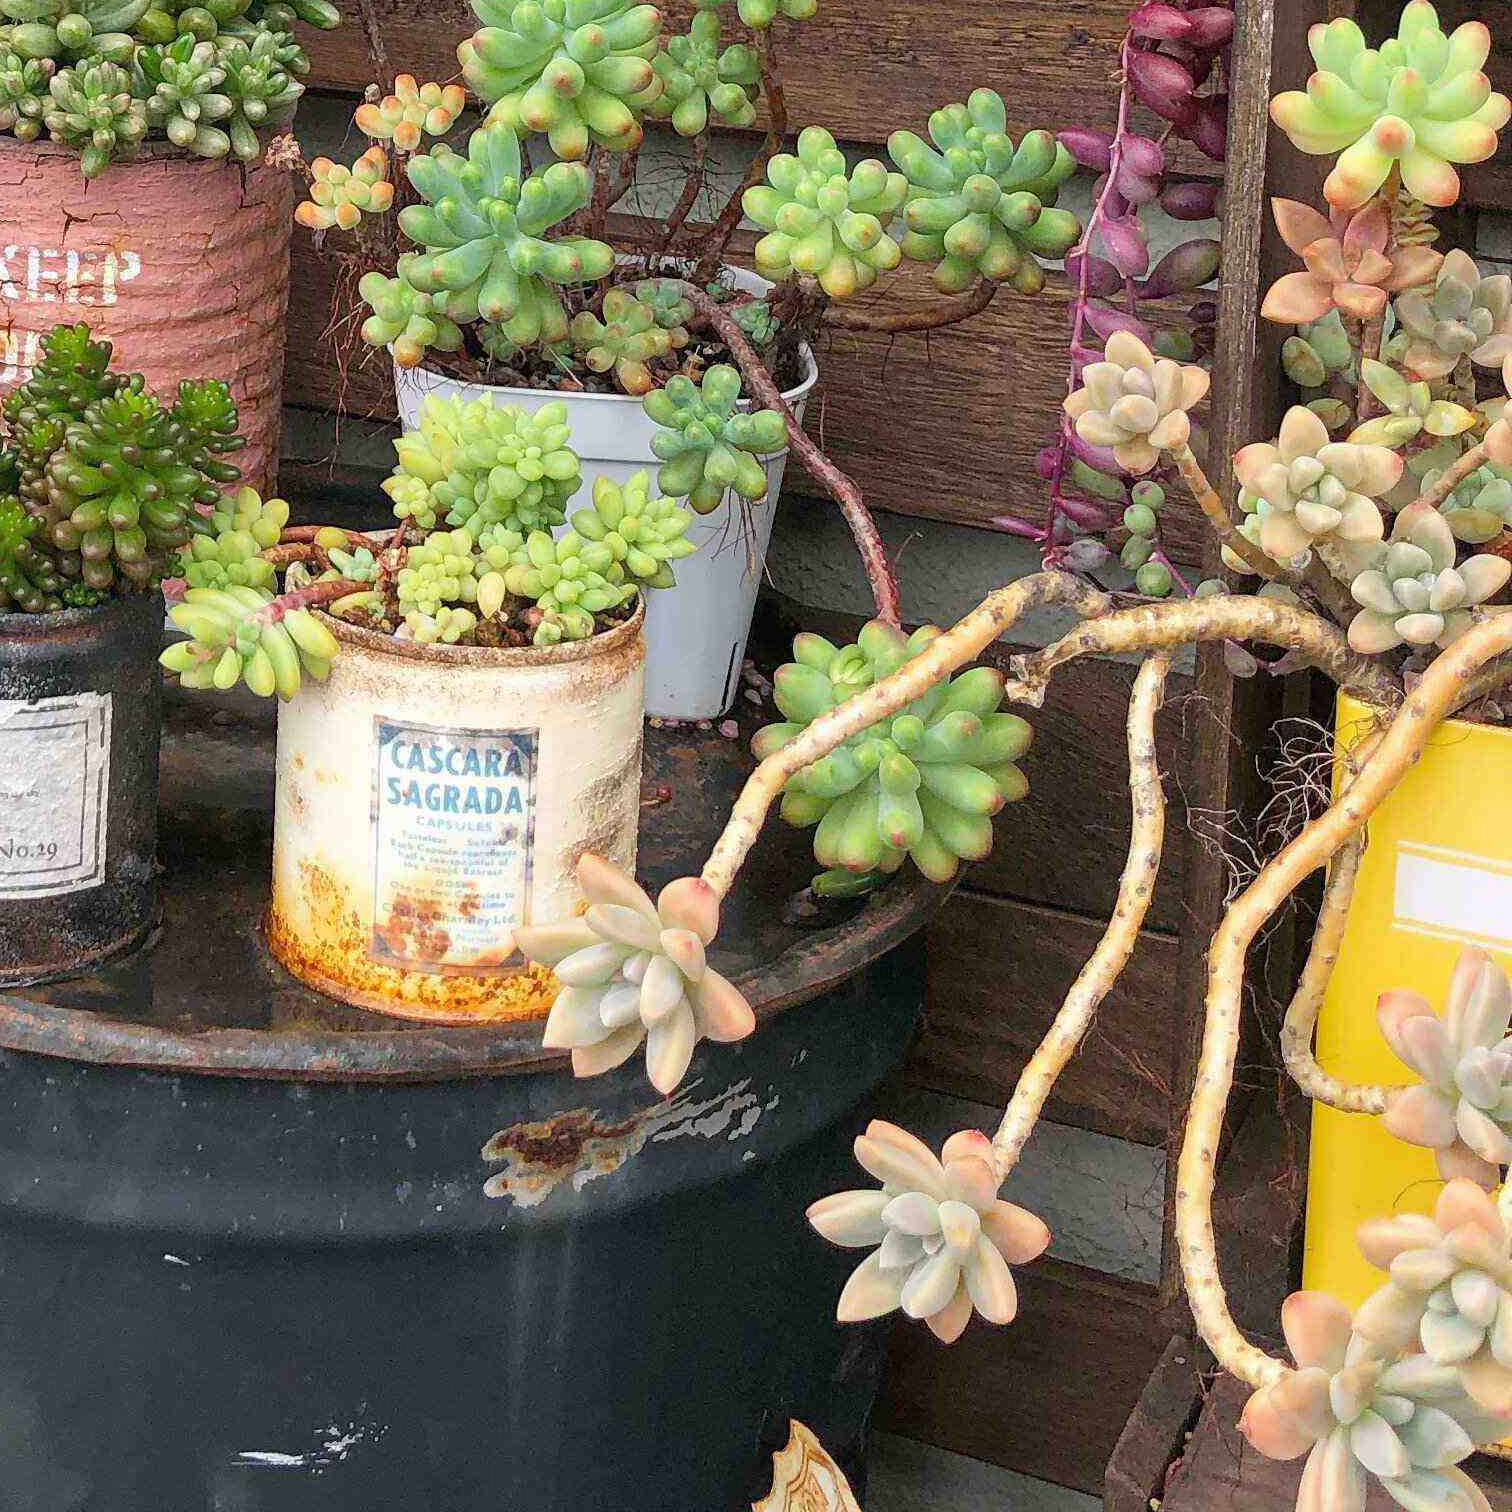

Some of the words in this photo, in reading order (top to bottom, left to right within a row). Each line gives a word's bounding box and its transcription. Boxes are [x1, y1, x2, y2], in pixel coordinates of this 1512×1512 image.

[390, 739, 524, 778] CASCARA
[386, 776, 523, 815] SAGRADA
[415, 815, 493, 833] CAPSULES
